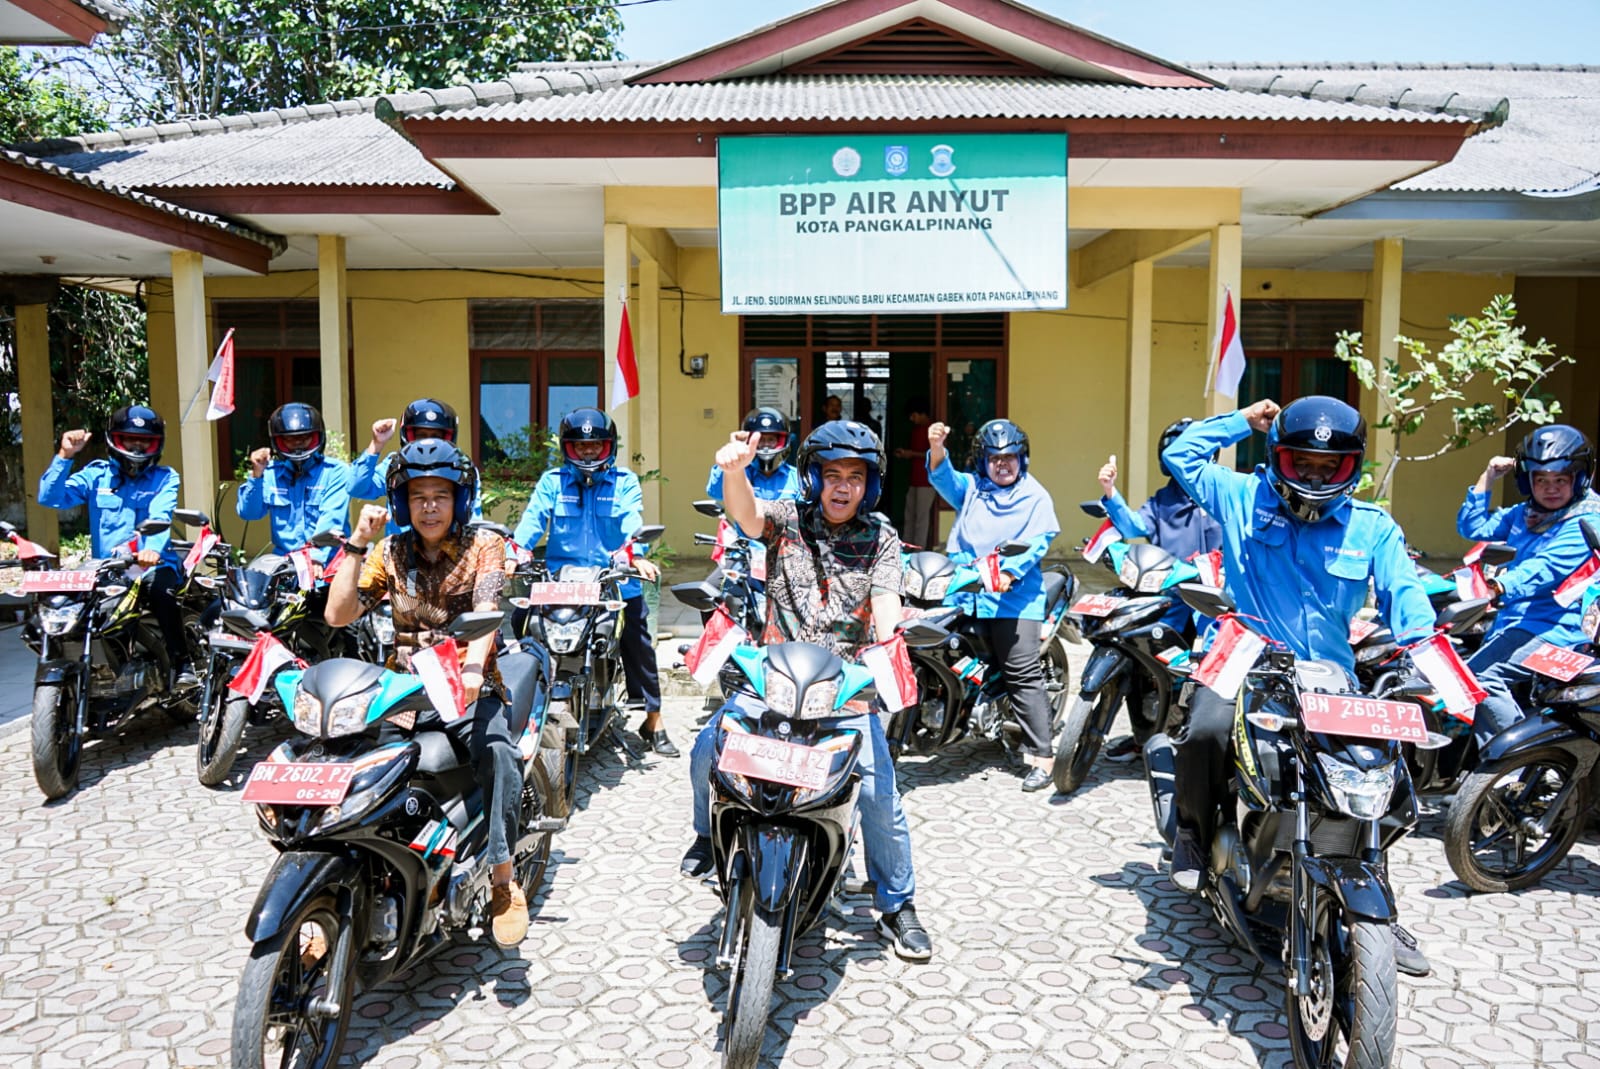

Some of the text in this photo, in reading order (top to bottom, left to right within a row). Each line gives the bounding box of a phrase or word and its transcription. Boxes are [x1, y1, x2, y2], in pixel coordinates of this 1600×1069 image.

[779, 189, 1010, 216] BPP AIR ANYUT
[796, 217, 993, 234] KOTA PANGKALPINANG
[732, 290, 1059, 306] JL. JEND. SUDIRMAN SELINDUNG BARU KECAMATAN GABEK KOTA PANGKALPINANG
[1305, 695, 1422, 722] BN 2605 PZ
[253, 765, 352, 783] BN 2602 PZ
